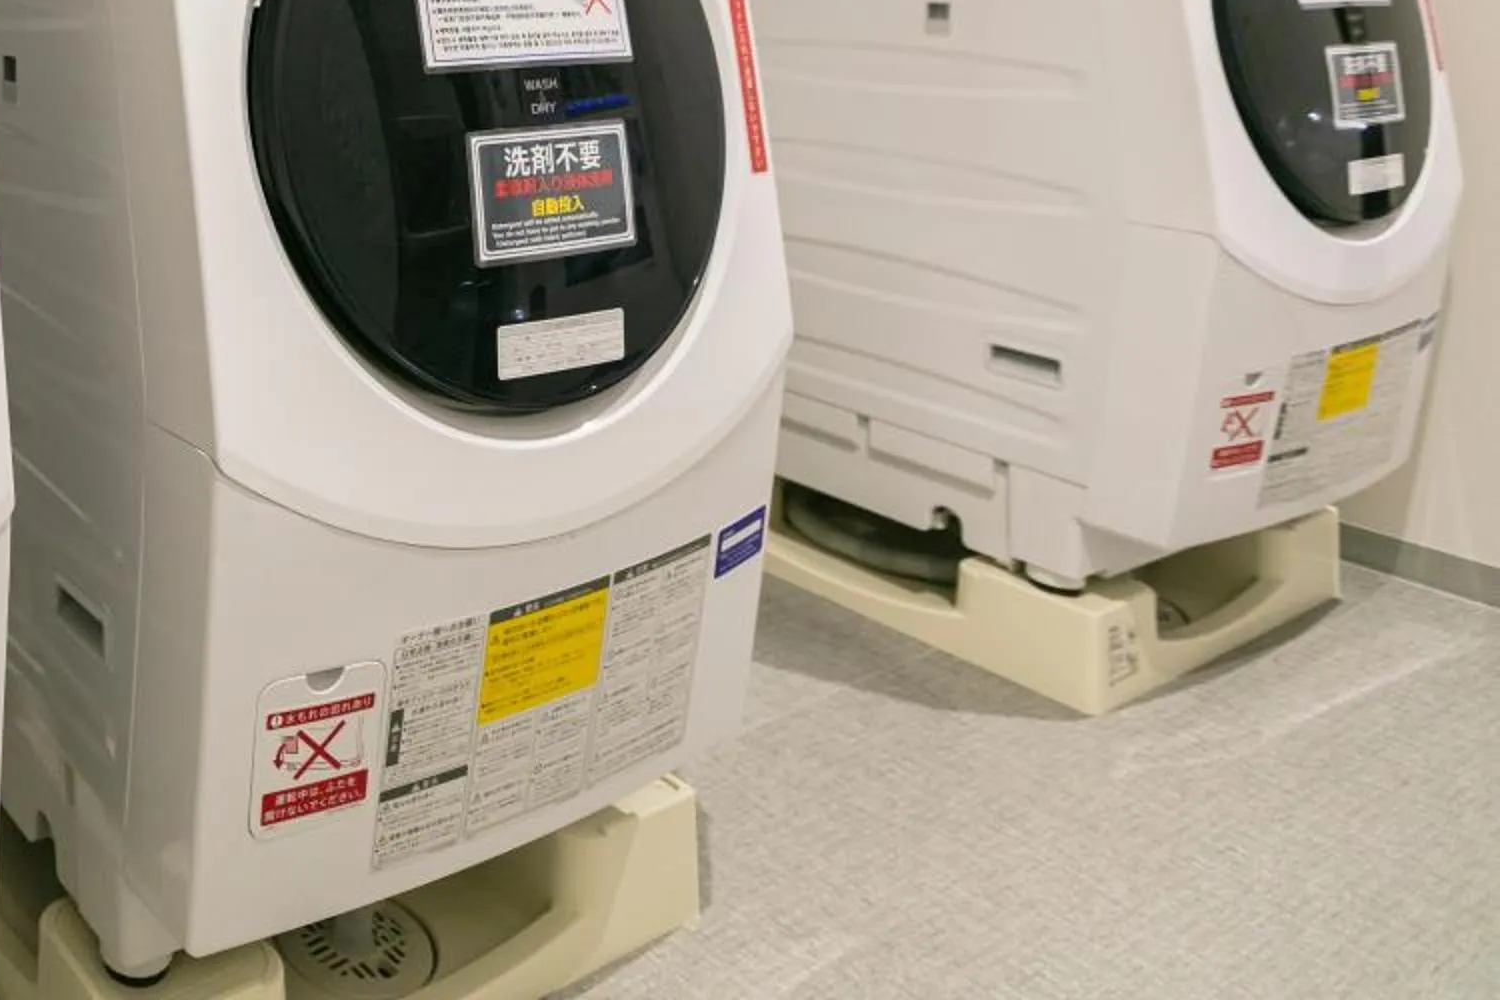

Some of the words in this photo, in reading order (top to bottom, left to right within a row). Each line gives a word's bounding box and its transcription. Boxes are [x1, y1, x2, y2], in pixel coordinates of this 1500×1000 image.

[524, 77, 559, 90] WASH
[531, 102, 556, 115] DRY
[503, 139, 602, 178] 洗剤不要
[531, 195, 585, 217] 自動投入
